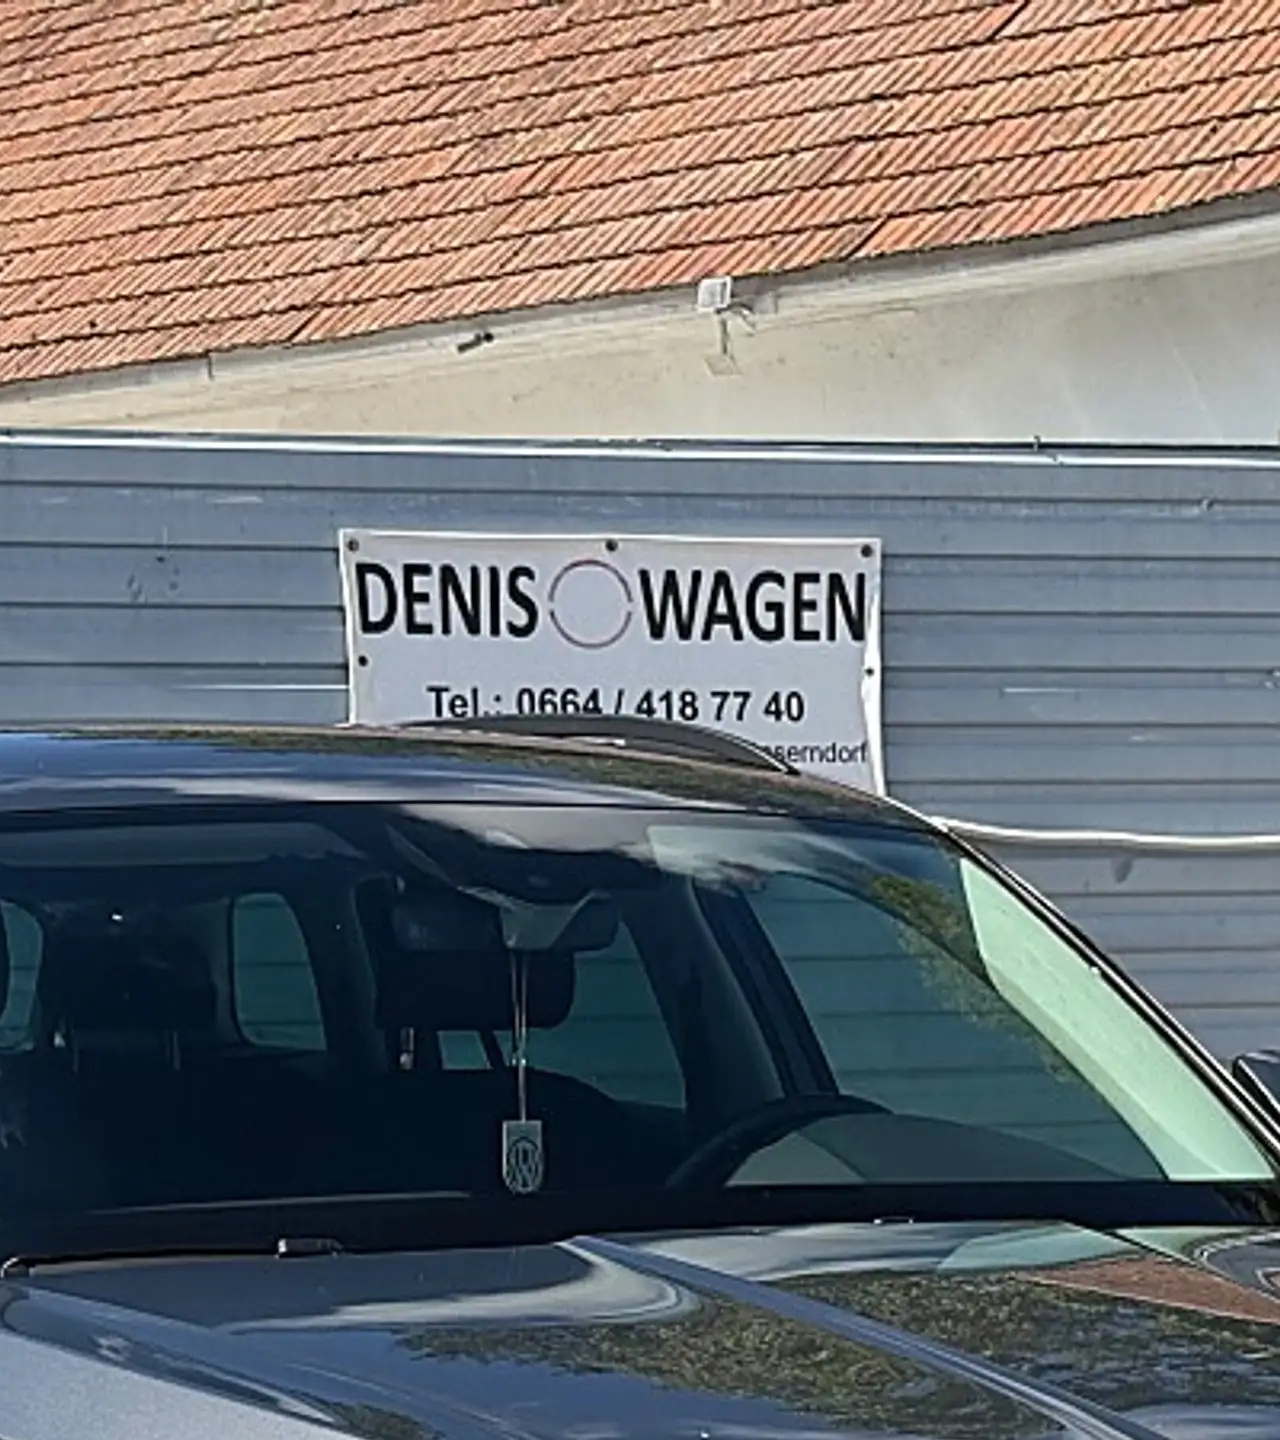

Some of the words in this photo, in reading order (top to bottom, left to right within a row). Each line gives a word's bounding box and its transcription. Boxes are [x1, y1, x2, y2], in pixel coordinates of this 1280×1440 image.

[356, 562, 539, 638] DENIS
[639, 568, 867, 642] WAGEN
[516, 687, 603, 715] 0664
[614, 688, 625, 715] /
[635, 689, 699, 720] 418
[710, 690, 752, 720] 77
[763, 690, 805, 722] 40
